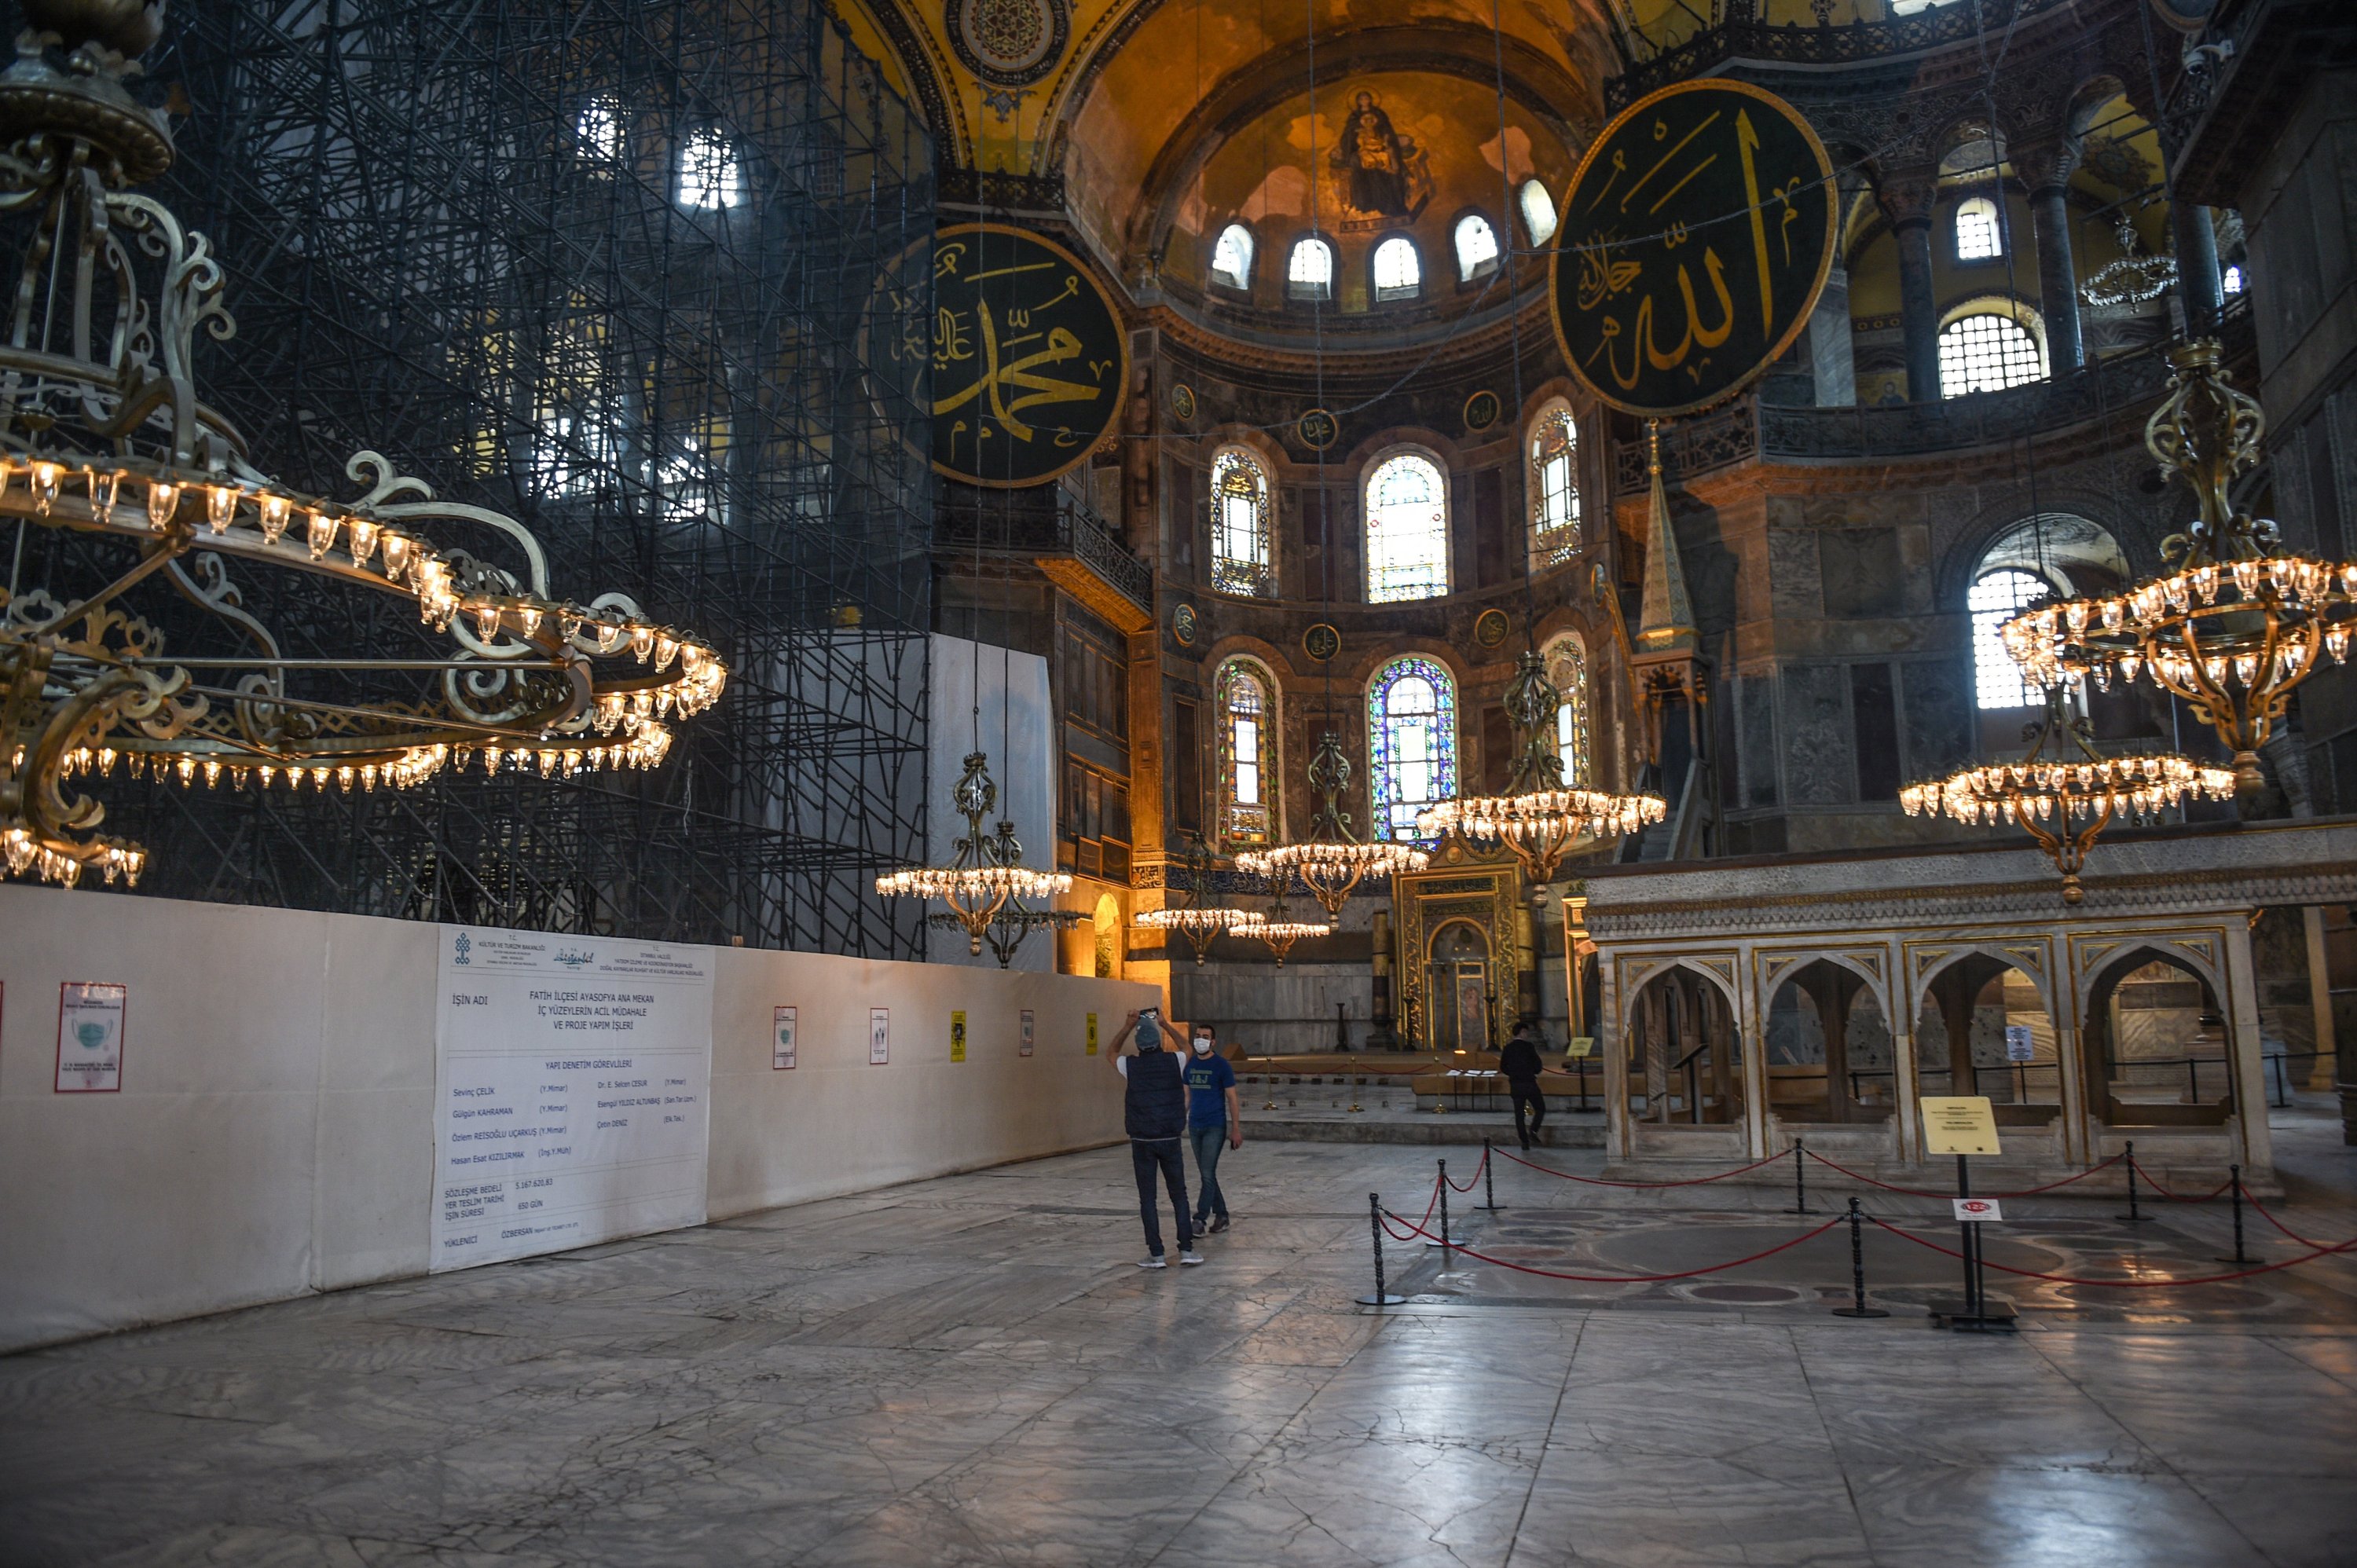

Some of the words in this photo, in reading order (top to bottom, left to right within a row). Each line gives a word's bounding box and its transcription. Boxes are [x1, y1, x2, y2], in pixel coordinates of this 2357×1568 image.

[453, 995, 471, 1007] İŞİN
[473, 995, 488, 1006] ADI
[530, 990, 552, 1001] FATİH
[553, 991, 578, 1003] İLÇESİ
[580, 993, 616, 1002] AYASOFYA
[632, 995, 654, 1004] MEKAN
[537, 1006, 547, 1017] İÇ
[548, 1004, 592, 1016] YÜZEYLERİN
[594, 1006, 610, 1017] ACİL
[611, 1006, 647, 1017] MÜDAHALE
[565, 1021, 588, 1030] PROJE
[589, 1021, 610, 1030] YAPIM
[612, 1020, 633, 1032] İŞLERİ
[546, 1061, 561, 1070] YAPI
[563, 1059, 591, 1070] DENETİM
[592, 1059, 632, 1069] GÖREVLİLERİ
[453, 1089, 475, 1097] Sevinç
[476, 1086, 495, 1097] ÇELİK
[477, 1107, 514, 1116] KAHRAMAN
[451, 1156, 471, 1165] Hasan
[445, 1186, 478, 1199] SÖZLEŞME
[480, 1183, 503, 1195] BEDELİ
[445, 1200, 457, 1210] YER
[459, 1196, 482, 1208] TESLİM
[483, 1194, 504, 1205] TARİHİ
[460, 1207, 484, 1218] SÜRESİ
[530, 1199, 544, 1209] GÜN
[501, 1226, 533, 1240] ÖZBERSAN
